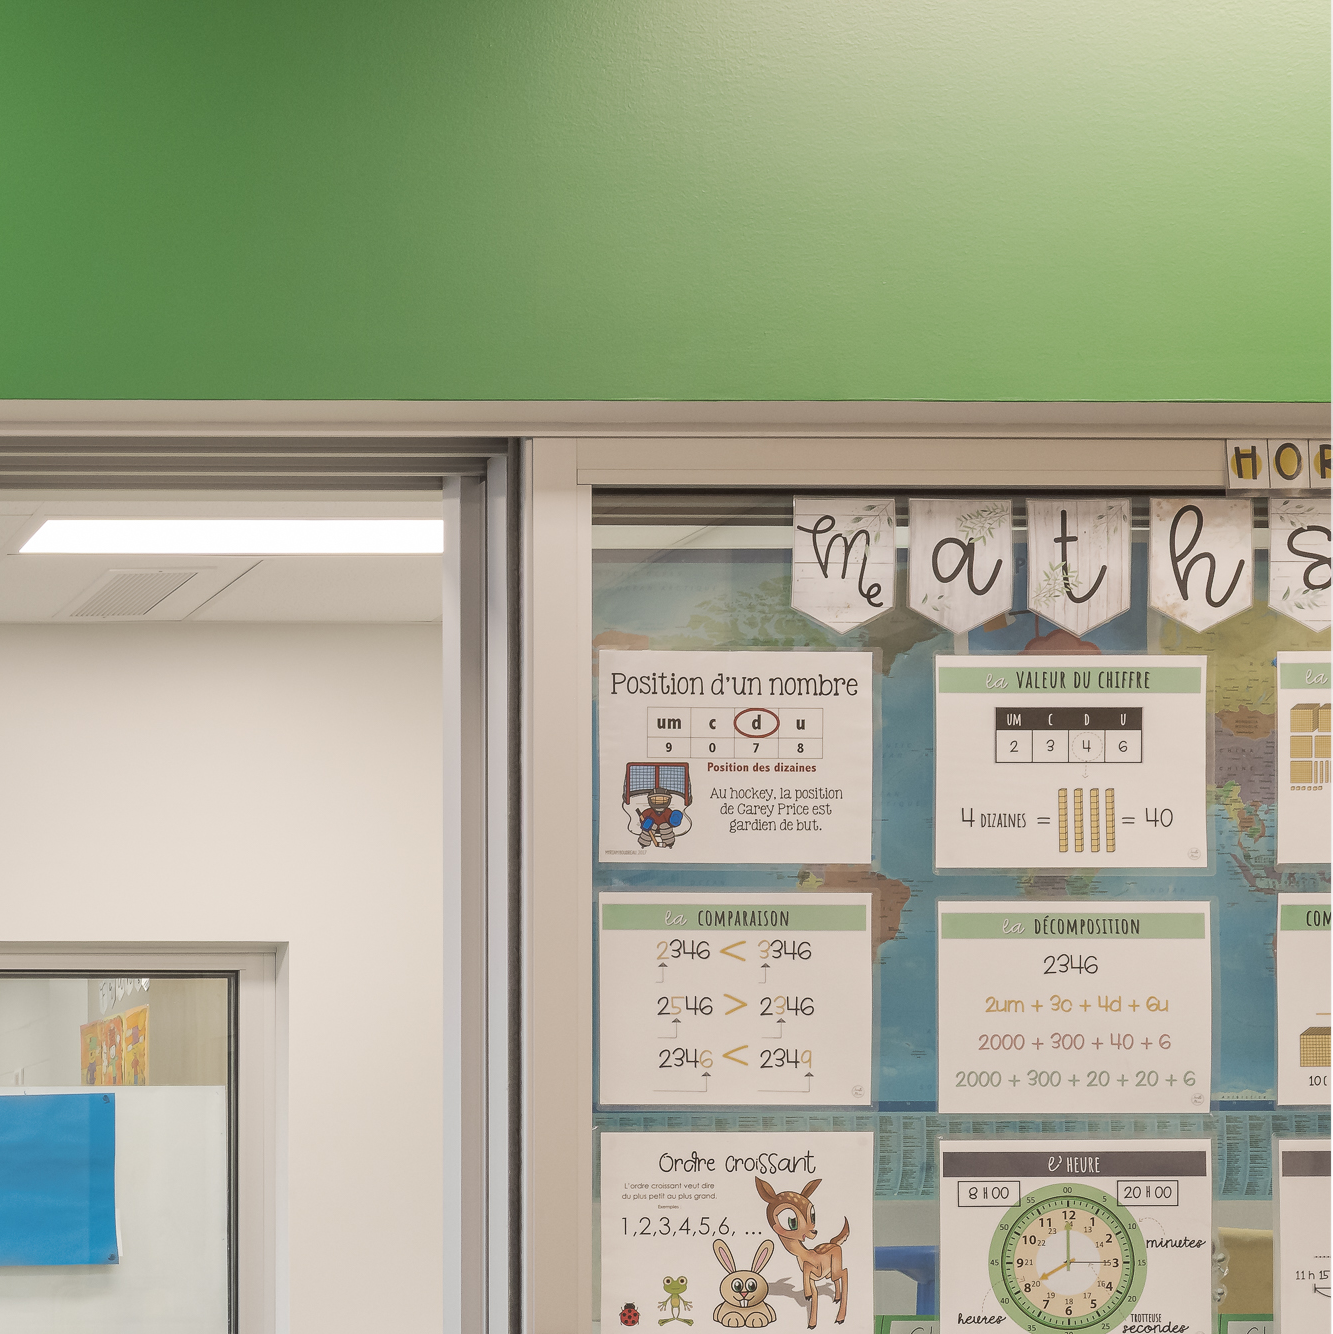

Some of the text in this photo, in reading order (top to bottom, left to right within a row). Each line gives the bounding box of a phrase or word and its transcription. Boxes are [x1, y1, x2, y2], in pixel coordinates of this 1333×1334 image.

[611, 673, 857, 696] Position d'un nombre
[986, 671, 1150, 689] la VALEUR DU CHIFFRE
[658, 715, 805, 730] um c d u
[1006, 713, 1126, 726] UM C D U
[666, 743, 803, 753] 9 0 7 8
[1009, 739, 1128, 753] 2 3 4 6
[708, 762, 816, 772] Position des dizaines
[710, 787, 842, 801] Au hockey, la position
[720, 803, 832, 817] de Carey Price est
[962, 808, 1026, 828] 4 DIZAINES
[1146, 808, 1173, 827] 40
[730, 819, 822, 833] gardien de but.
[665, 910, 788, 927] la COMPARAISON
[1003, 915, 1139, 935] la DÉCOMPOSITION
[656, 938, 812, 960] 2346 3346
[1044, 954, 1098, 974] 2346
[656, 995, 815, 1016] 2546 2346
[985, 994, 1169, 1013] 2um 3c 4d 6u
[978, 1032, 1172, 1051] 2000 300 40 6
[658, 1047, 812, 1069] 2346 2349
[955, 1069, 1196, 1088] 2000 300 20 20 6
[659, 1151, 715, 1172] Ordre
[1066, 1156, 1101, 1174] HEURE
[968, 1187, 977, 1200] 8
[983, 1186, 989, 1199] H
[1124, 1185, 1142, 1199] 20
[1145, 1185, 1151, 1198] H
[1145, 1237, 1207, 1249] minutes
[1294, 1270, 1305, 1281] 11
[1308, 1270, 1316, 1281] h
[957, 1313, 1007, 1326] heures
[1130, 1313, 1162, 1323] TROTTEUSE
[1122, 1323, 1189, 1334] secondes
